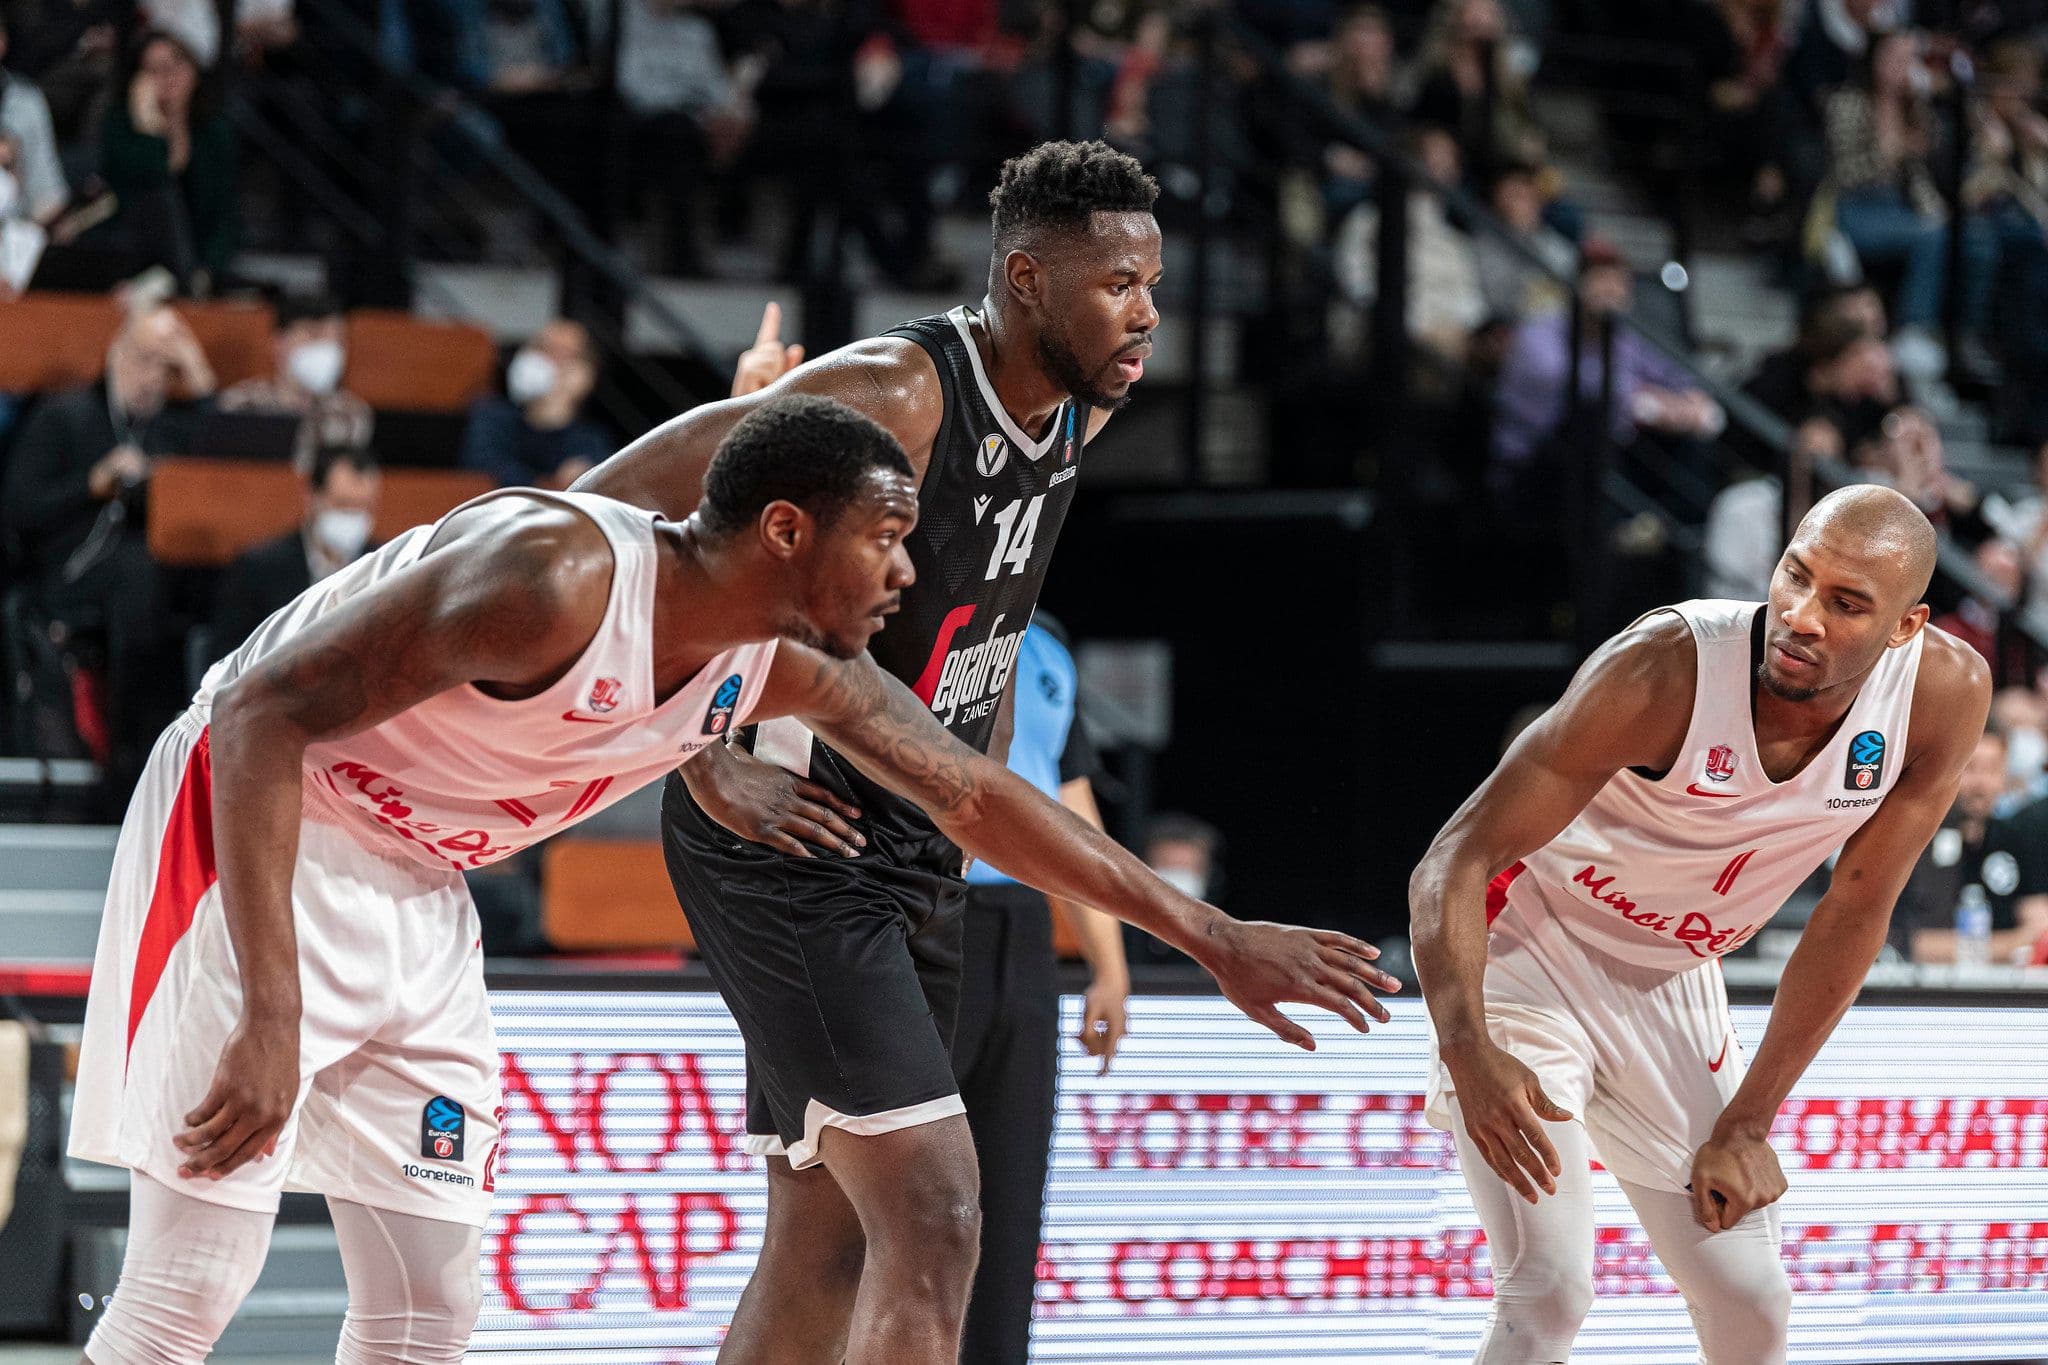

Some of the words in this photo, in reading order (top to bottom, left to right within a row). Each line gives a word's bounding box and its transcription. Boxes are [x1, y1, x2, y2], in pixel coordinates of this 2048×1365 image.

[984, 493, 1047, 581] 14
[1573, 865, 1674, 931] Minci
[1077, 1093, 1321, 1170] VOTRE
[493, 1192, 737, 1314] CAP
